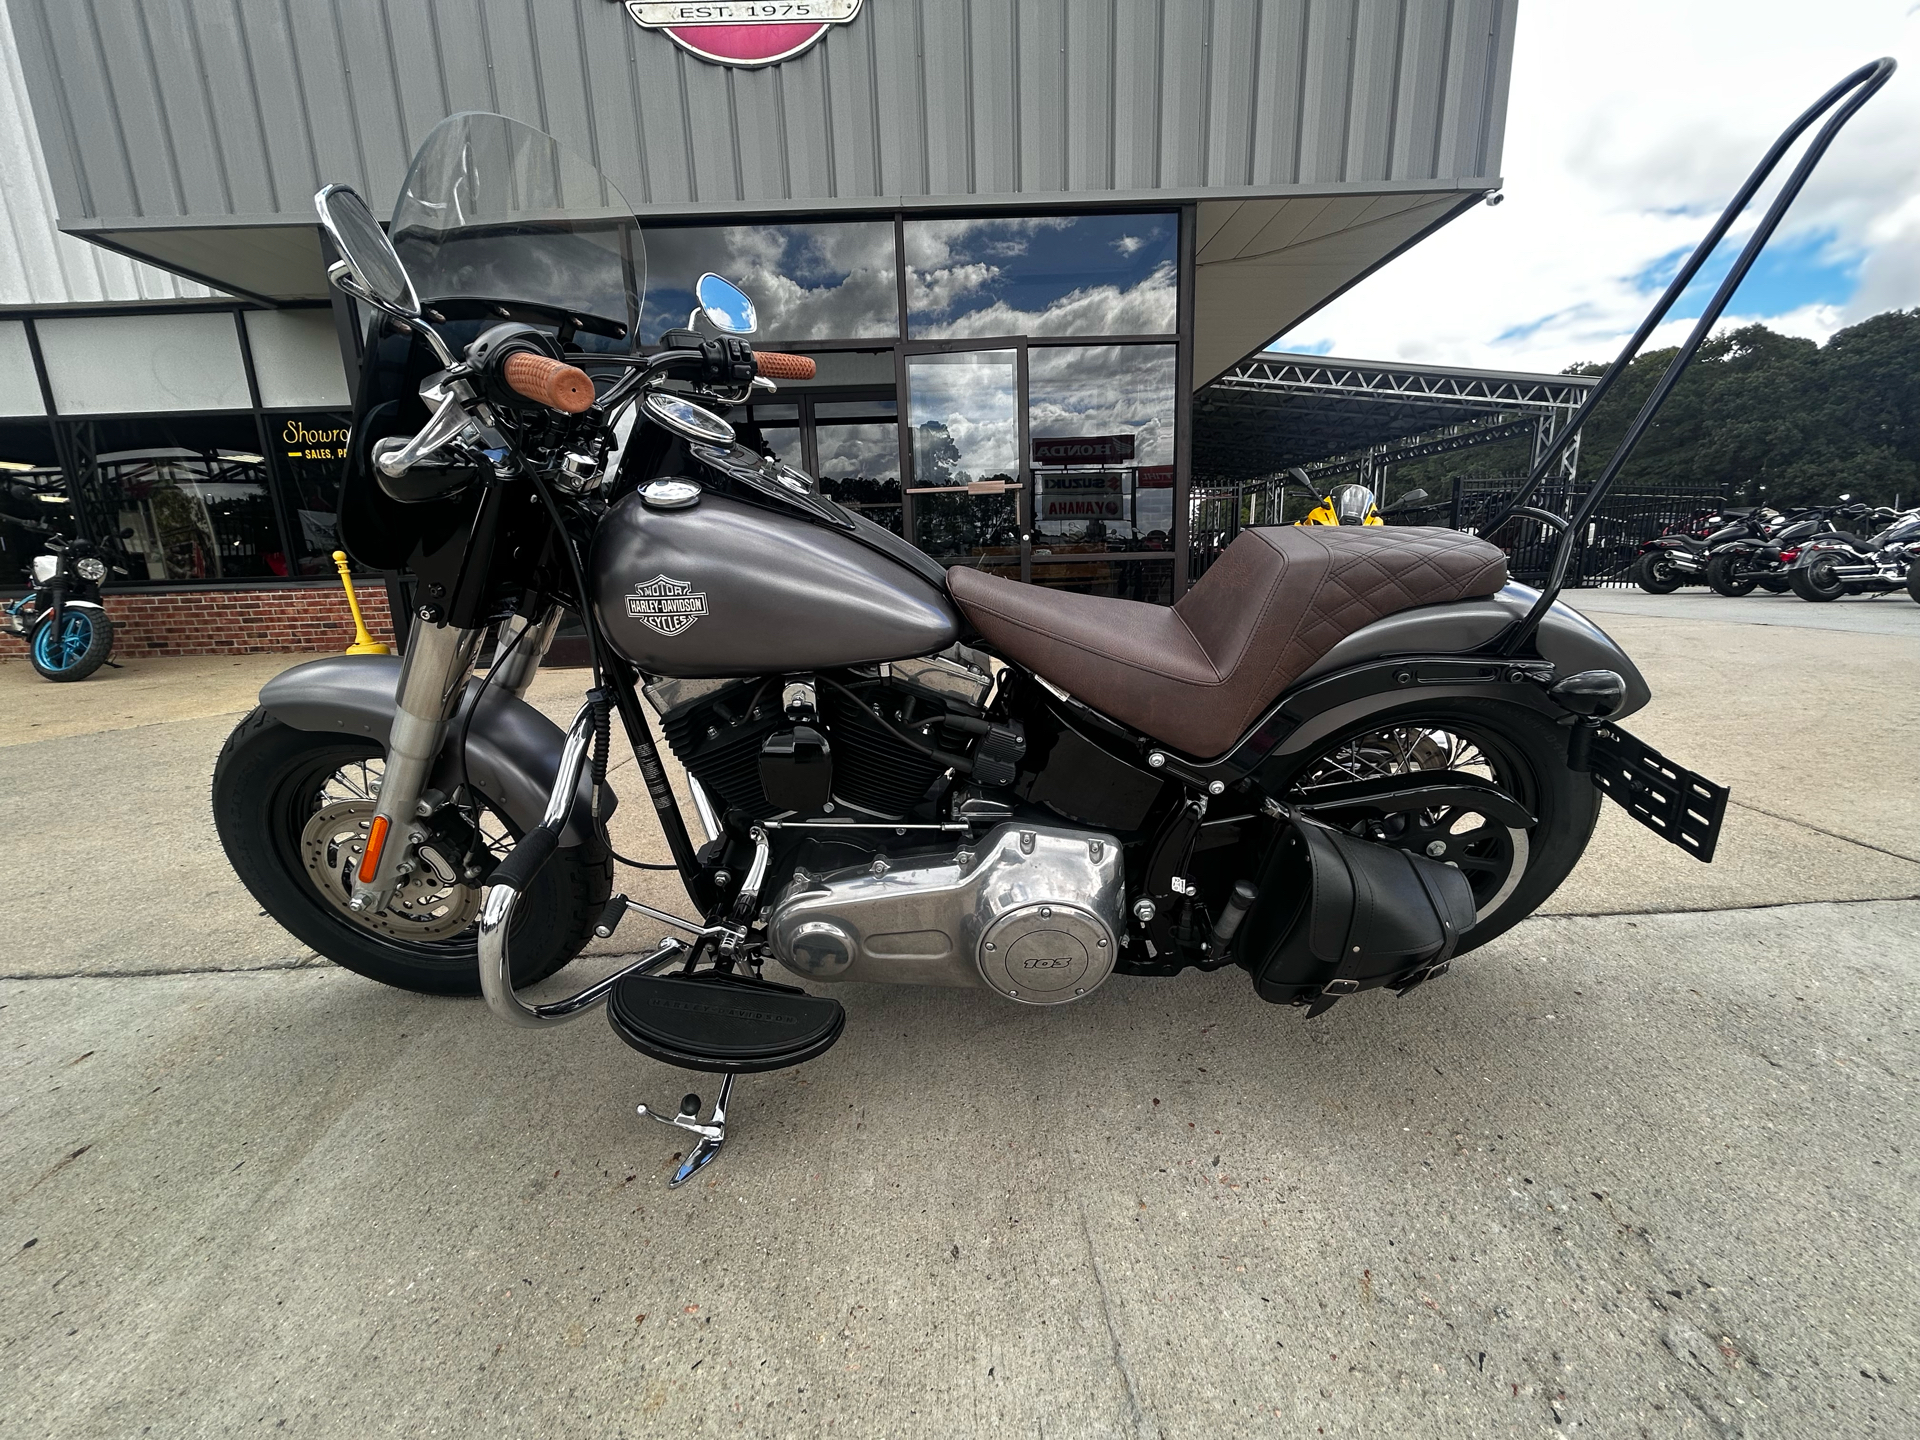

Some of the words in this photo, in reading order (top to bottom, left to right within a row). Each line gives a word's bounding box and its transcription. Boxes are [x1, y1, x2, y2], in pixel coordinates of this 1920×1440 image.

[679, 7, 733, 19] EST.
[749, 5, 810, 17] 1975
[305, 449, 334, 459] SALES,
[643, 581, 682, 596] MOTOR
[630, 598, 702, 613] HARLEY-DAVIDSON
[649, 615, 686, 631] CYCLES
[652, 999, 794, 1024] HARLEY-DAVIDSON
